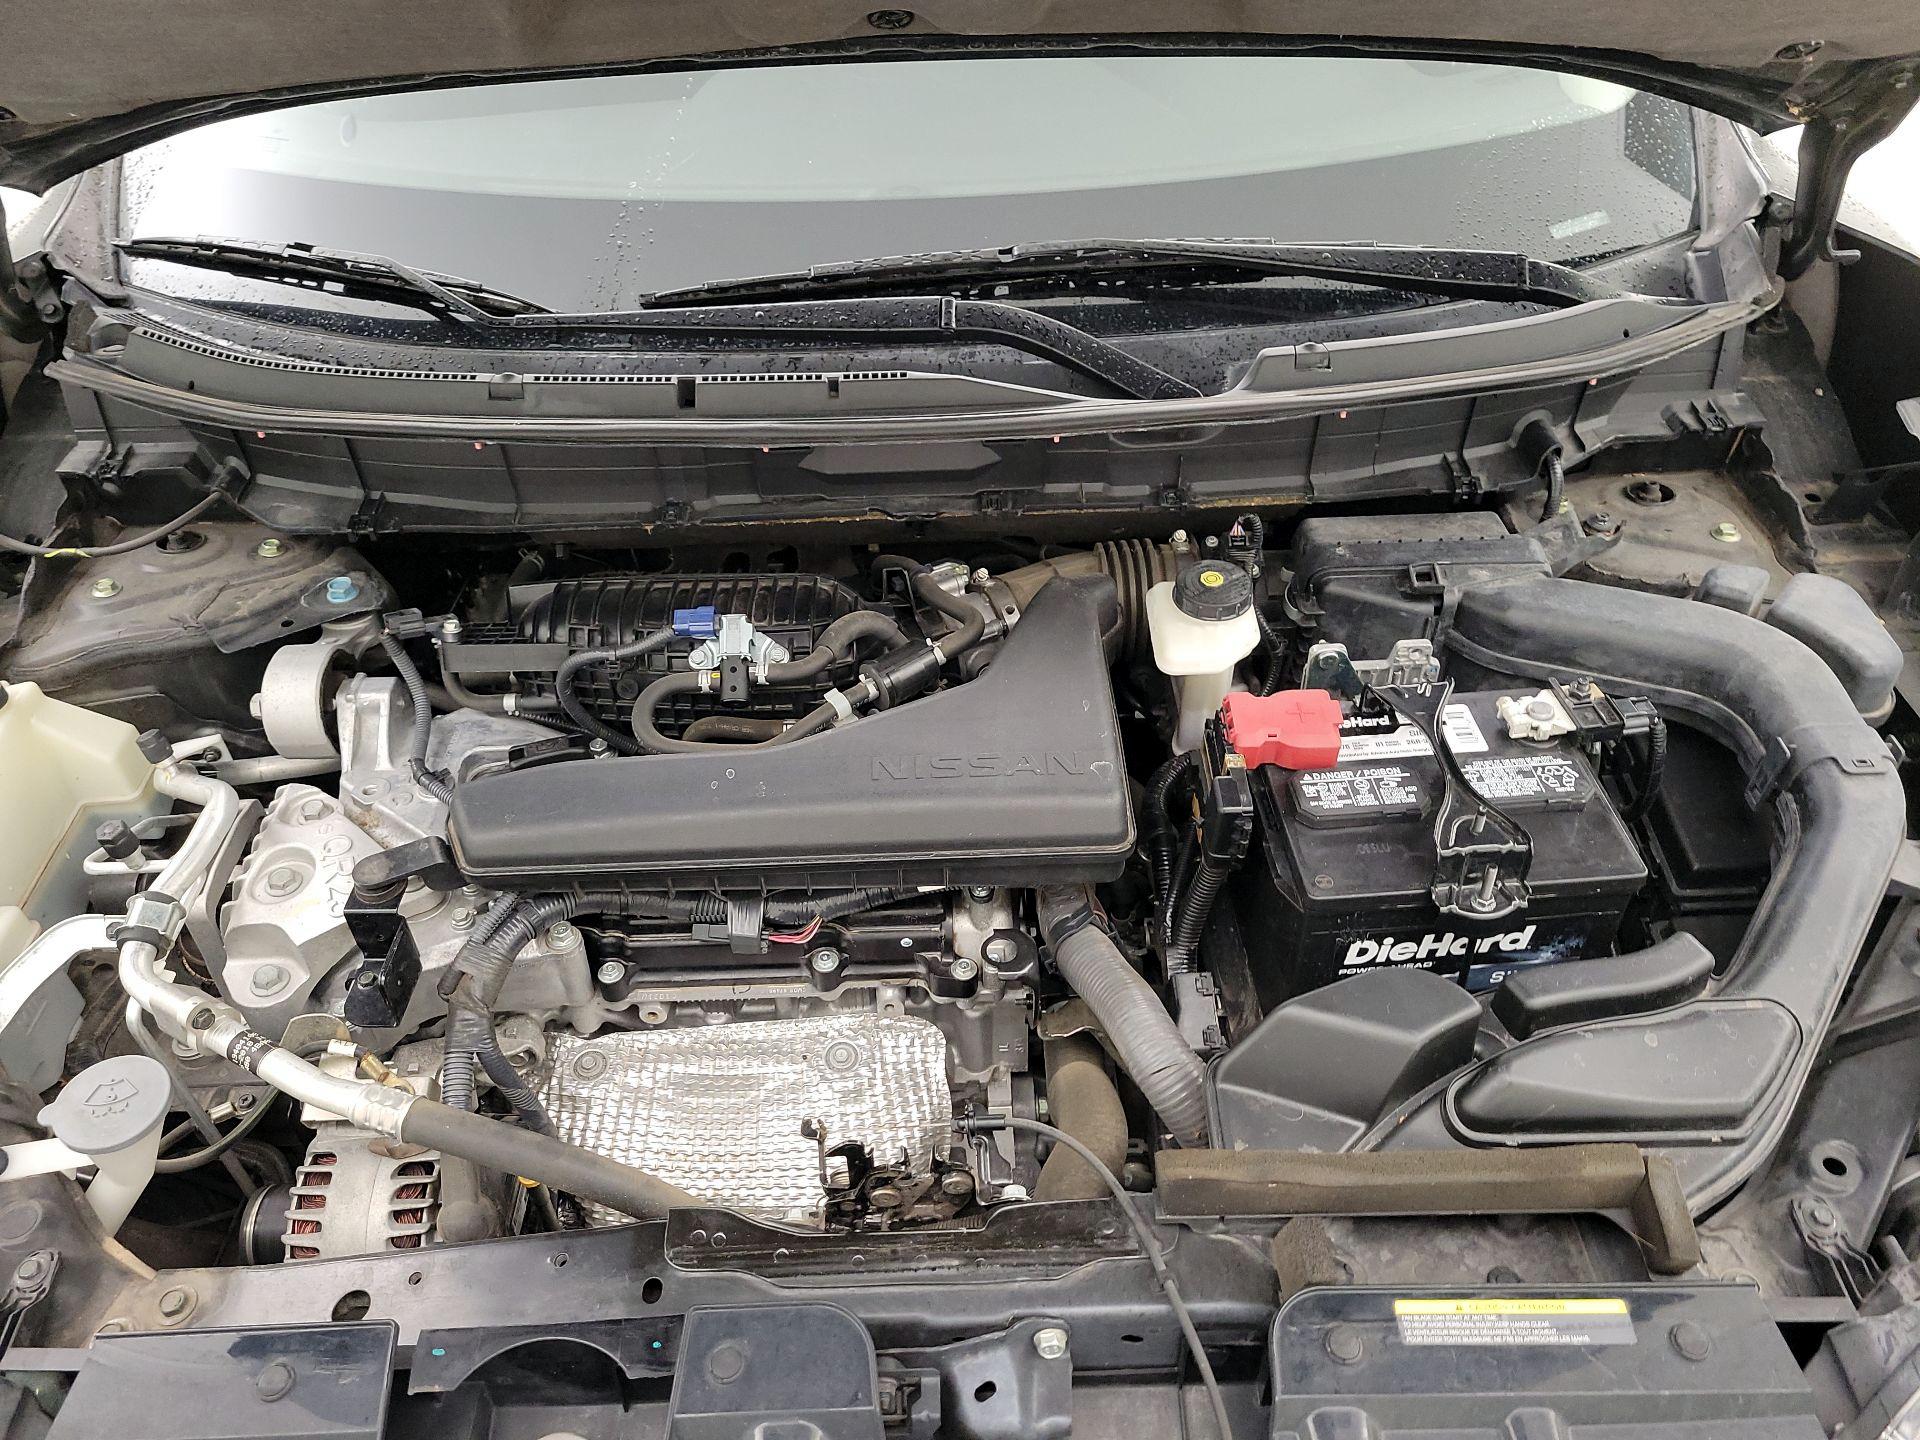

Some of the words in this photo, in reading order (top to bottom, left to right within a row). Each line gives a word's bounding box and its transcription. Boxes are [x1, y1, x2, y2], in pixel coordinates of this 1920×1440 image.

[871, 751, 1084, 781] NISSAN
[1312, 771, 1354, 779] DANGER
[1363, 767, 1401, 777] POISON
[1343, 925, 1537, 965] DieHard
